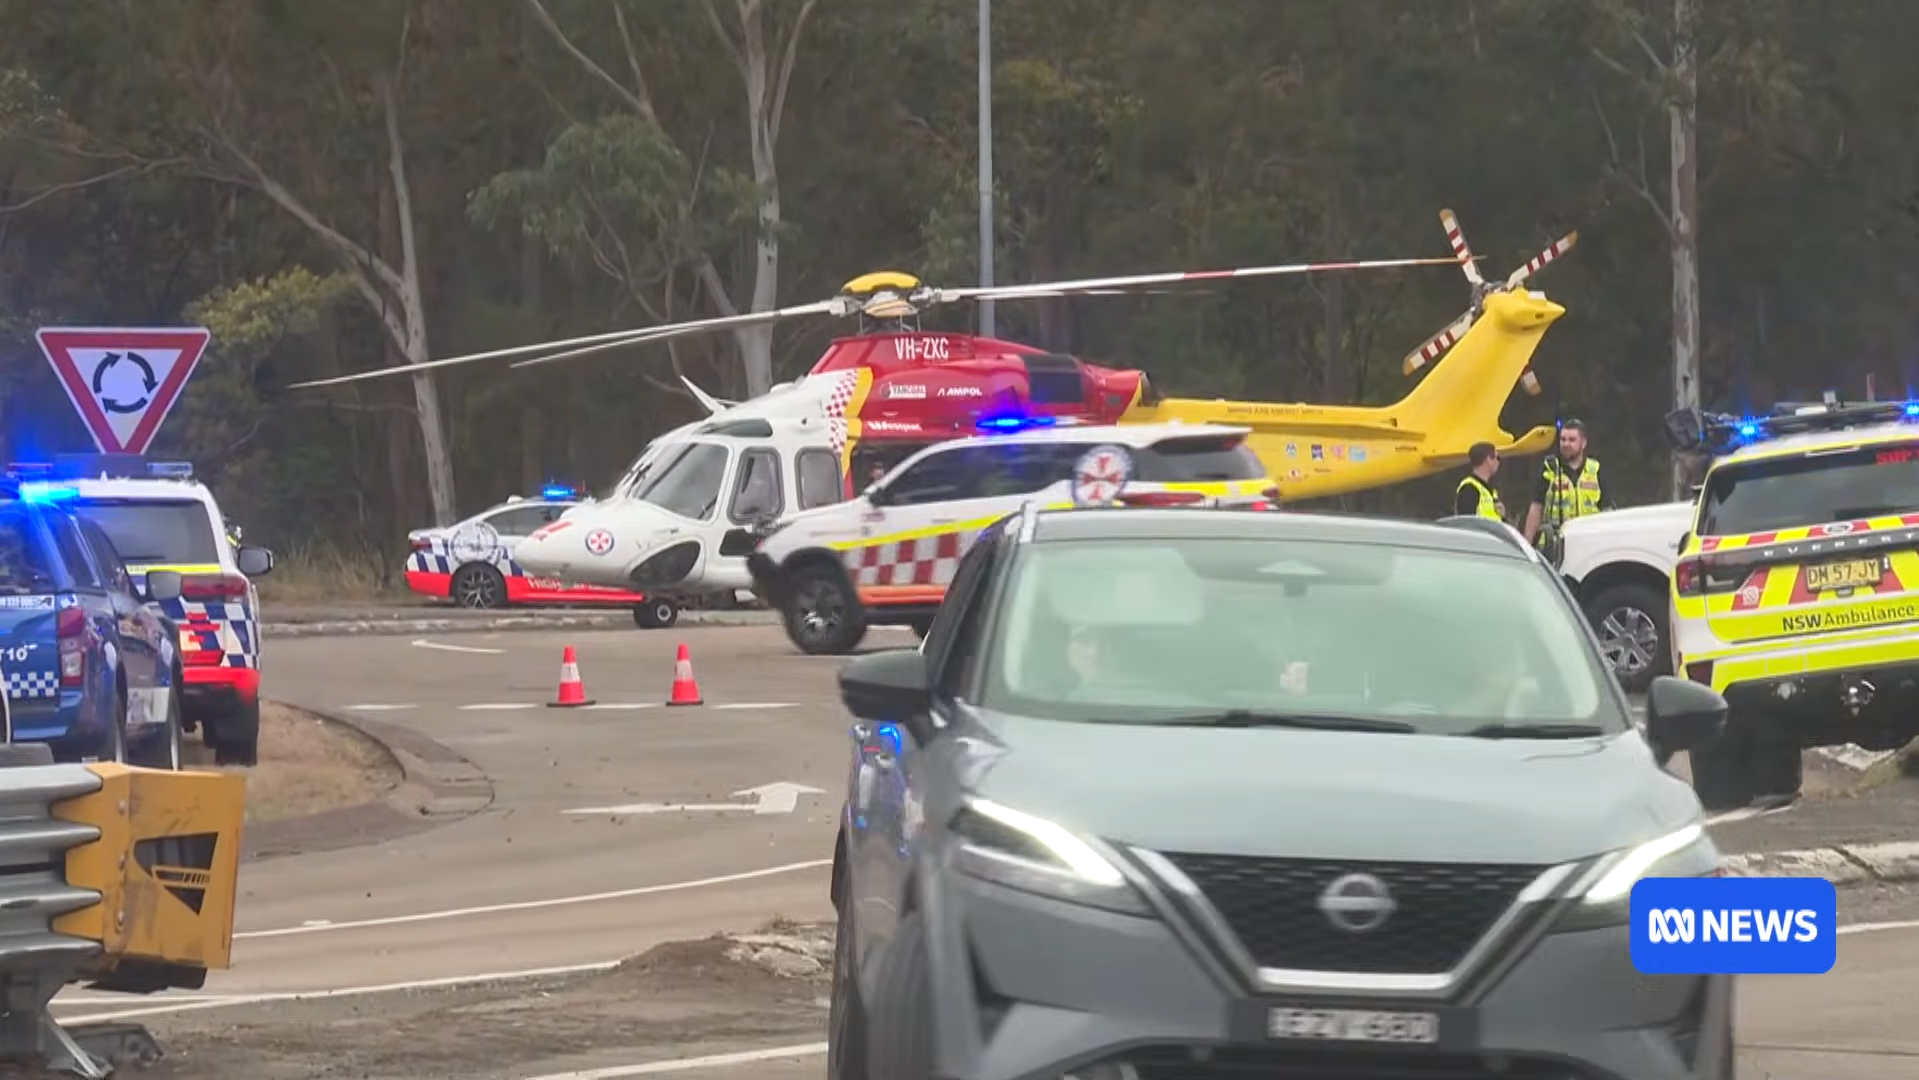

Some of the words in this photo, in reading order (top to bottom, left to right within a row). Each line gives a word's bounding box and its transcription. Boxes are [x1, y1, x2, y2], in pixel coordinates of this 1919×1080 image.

[894, 337, 949, 360] VH-ZXC
[946, 387, 983, 396] AMPOL
[867, 420, 922, 432] Westpac
[1763, 532, 1916, 558] EVEREST
[1808, 566, 1829, 585] DM
[1858, 560, 1877, 578] JY
[1782, 613, 1822, 632] NSW
[1824, 604, 1916, 626] Ambulance
